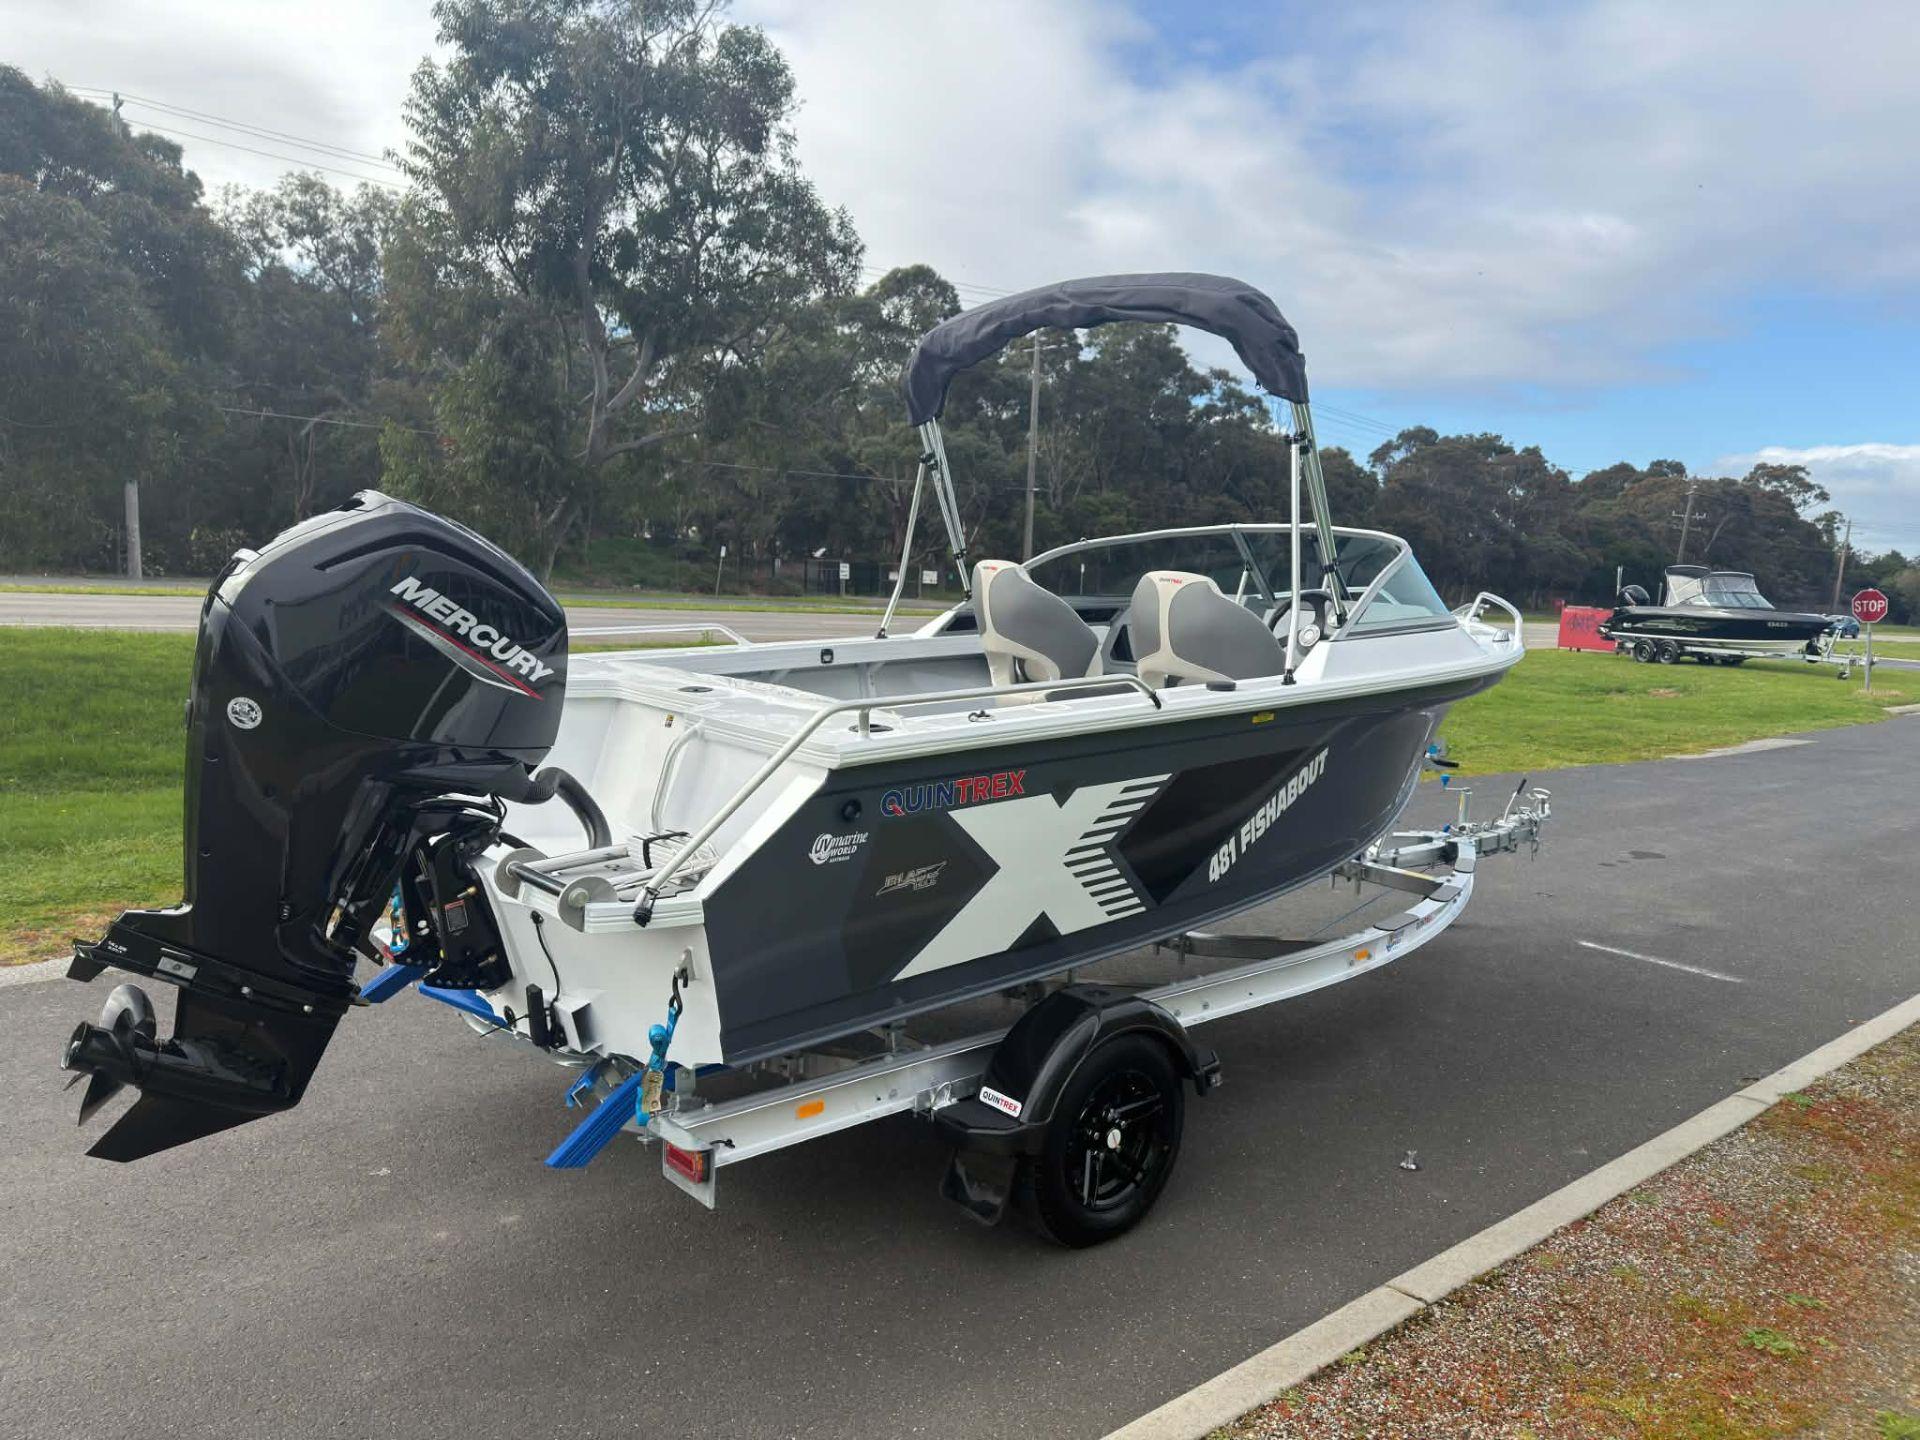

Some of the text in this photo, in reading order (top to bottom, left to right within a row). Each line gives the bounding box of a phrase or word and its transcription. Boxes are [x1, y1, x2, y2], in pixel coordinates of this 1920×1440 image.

[1854, 600, 1886, 613] STOP
[390, 576, 554, 682] MERCURY
[880, 769, 1027, 817] QUINTREX
[1208, 746, 1330, 884] 481 FISHABOUT
[829, 831, 869, 848] marine
[830, 845, 858, 857] WORLD
[982, 1091, 1019, 1112] QUINTREX
